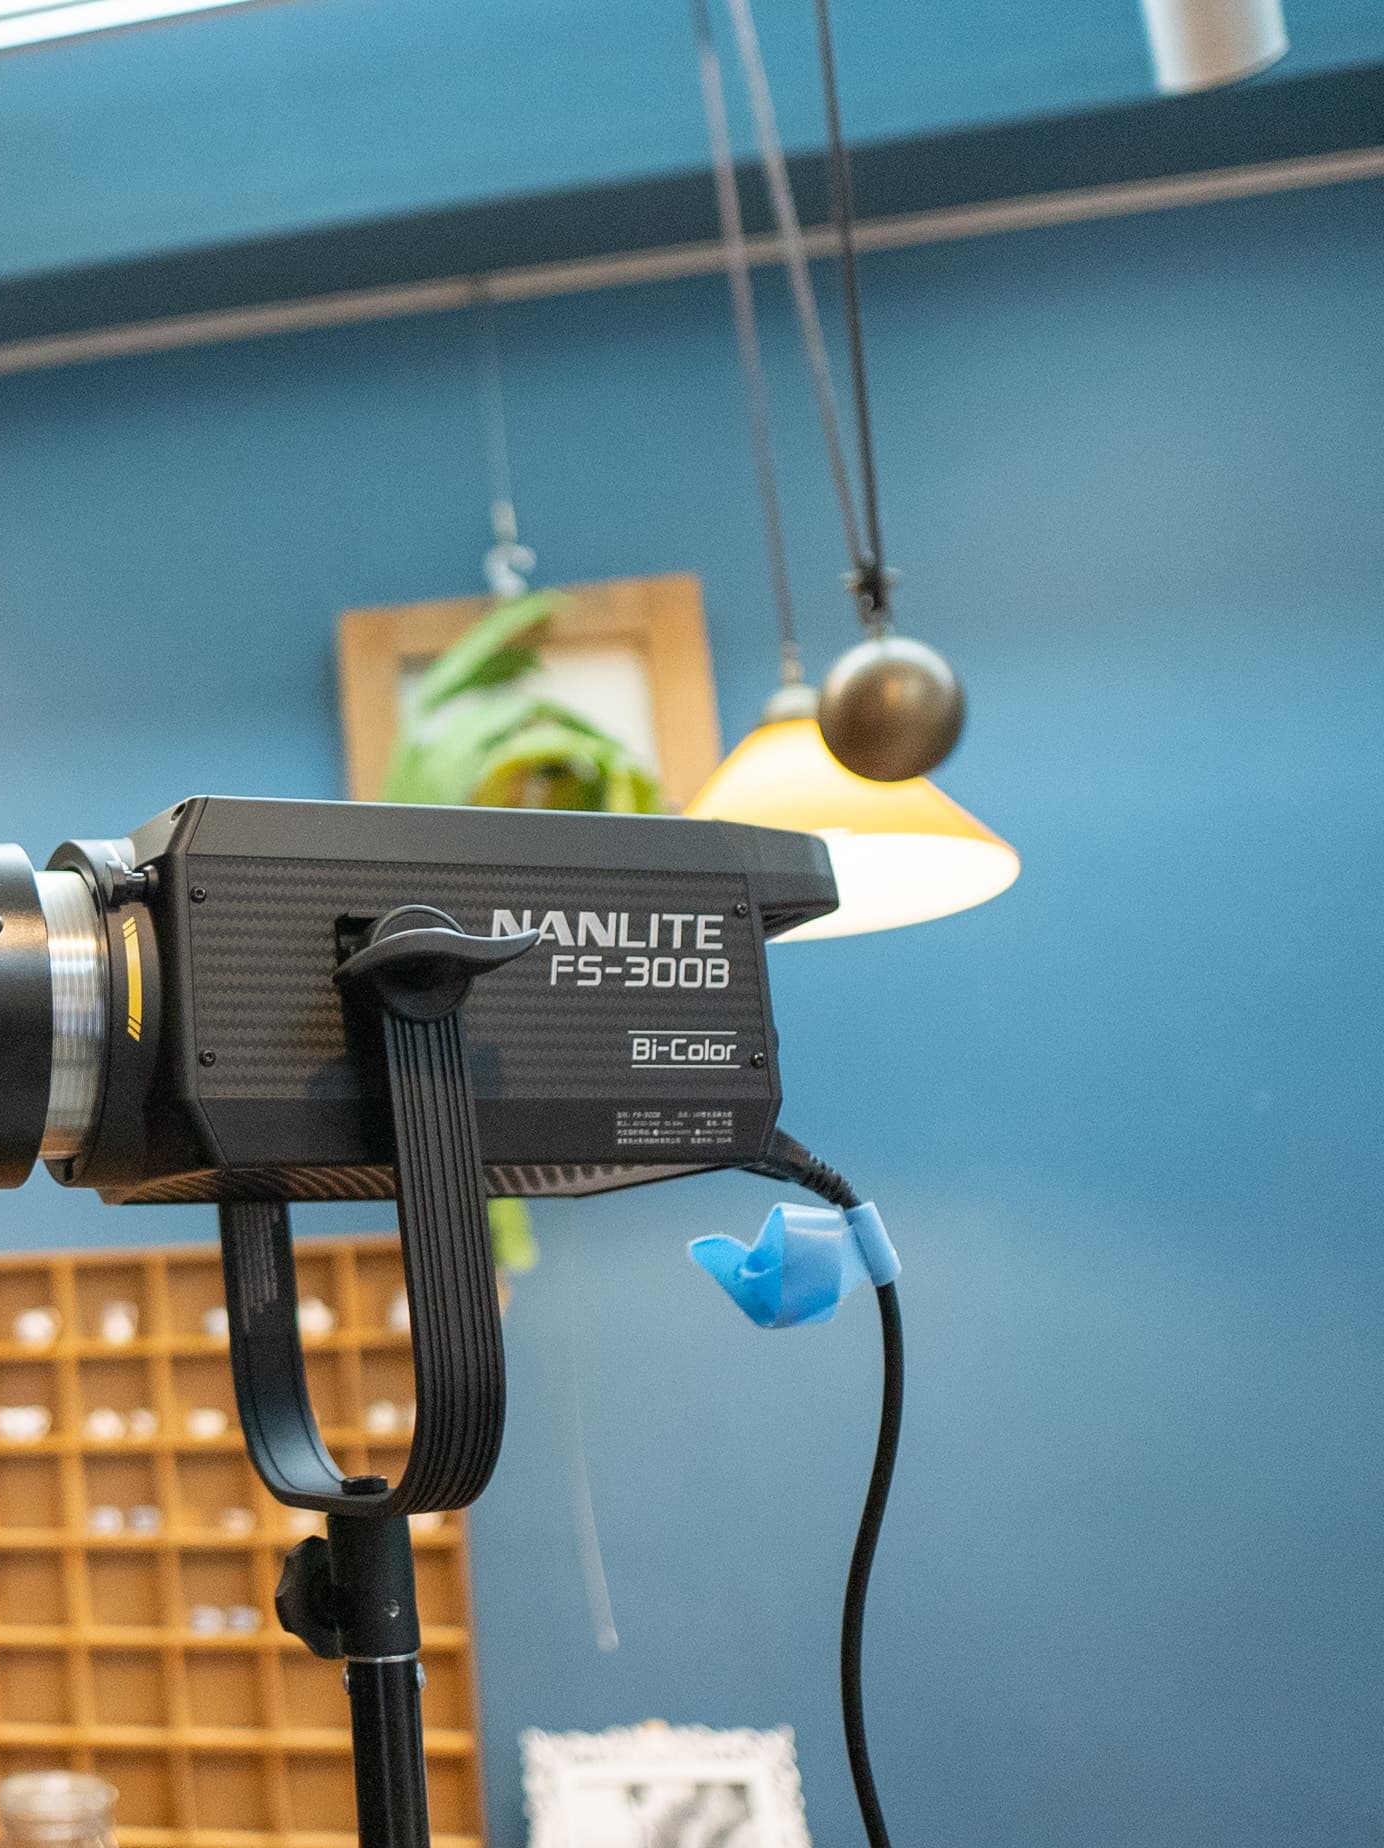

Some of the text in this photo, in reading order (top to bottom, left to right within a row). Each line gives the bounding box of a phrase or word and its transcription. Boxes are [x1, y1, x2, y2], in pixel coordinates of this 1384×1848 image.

[492, 909, 724, 949] NANLITE
[550, 955, 730, 989] FS-300B
[632, 1038, 737, 1061] Bi-Color
